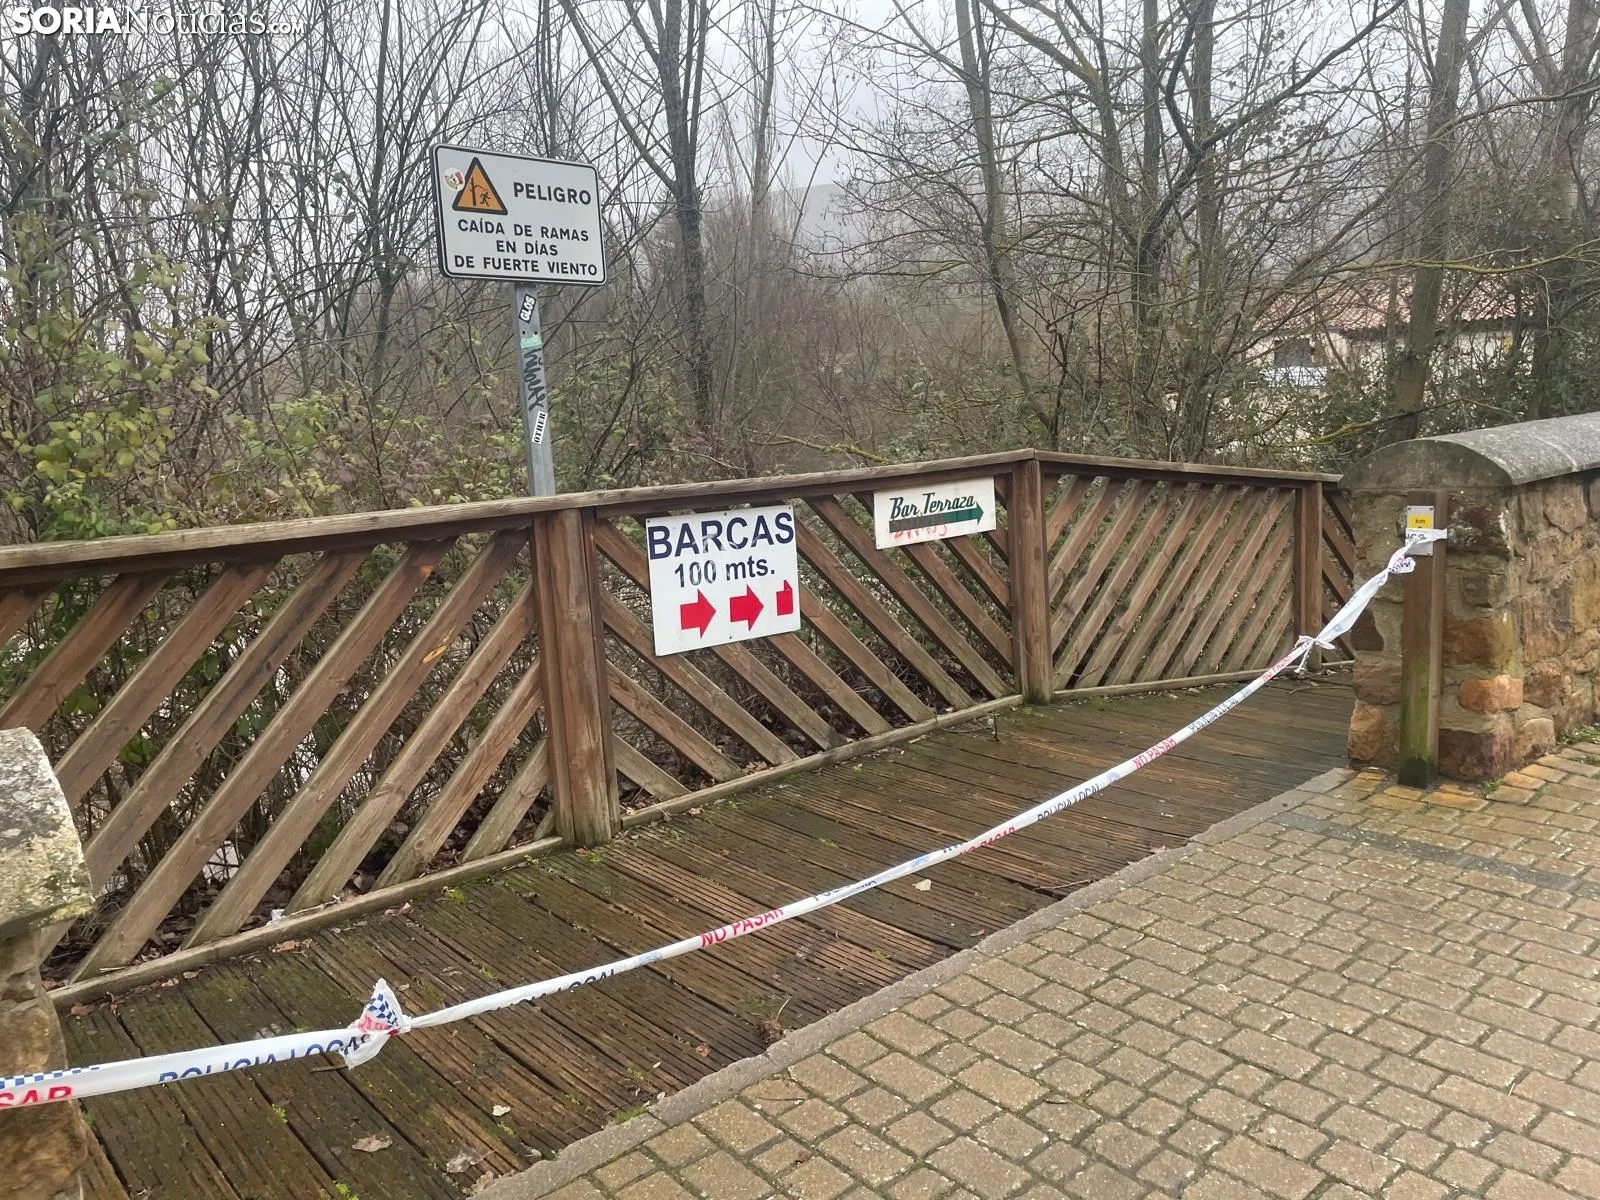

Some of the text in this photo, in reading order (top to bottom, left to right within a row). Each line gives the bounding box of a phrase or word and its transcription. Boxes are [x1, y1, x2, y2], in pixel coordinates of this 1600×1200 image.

[513, 182, 591, 205] PELIGRO
[457, 218, 589, 242] CAÍDA DE RAMAS
[496, 240, 559, 256] EN DÍAS
[454, 255, 598, 276] DE FUERTE VIENTO
[534, 412, 546, 443] OTHER
[889, 492, 975, 520] Bar Terraza
[647, 512, 794, 560] BARCAS
[674, 555, 775, 588] 100 mts.
[701, 929, 726, 947] NO
